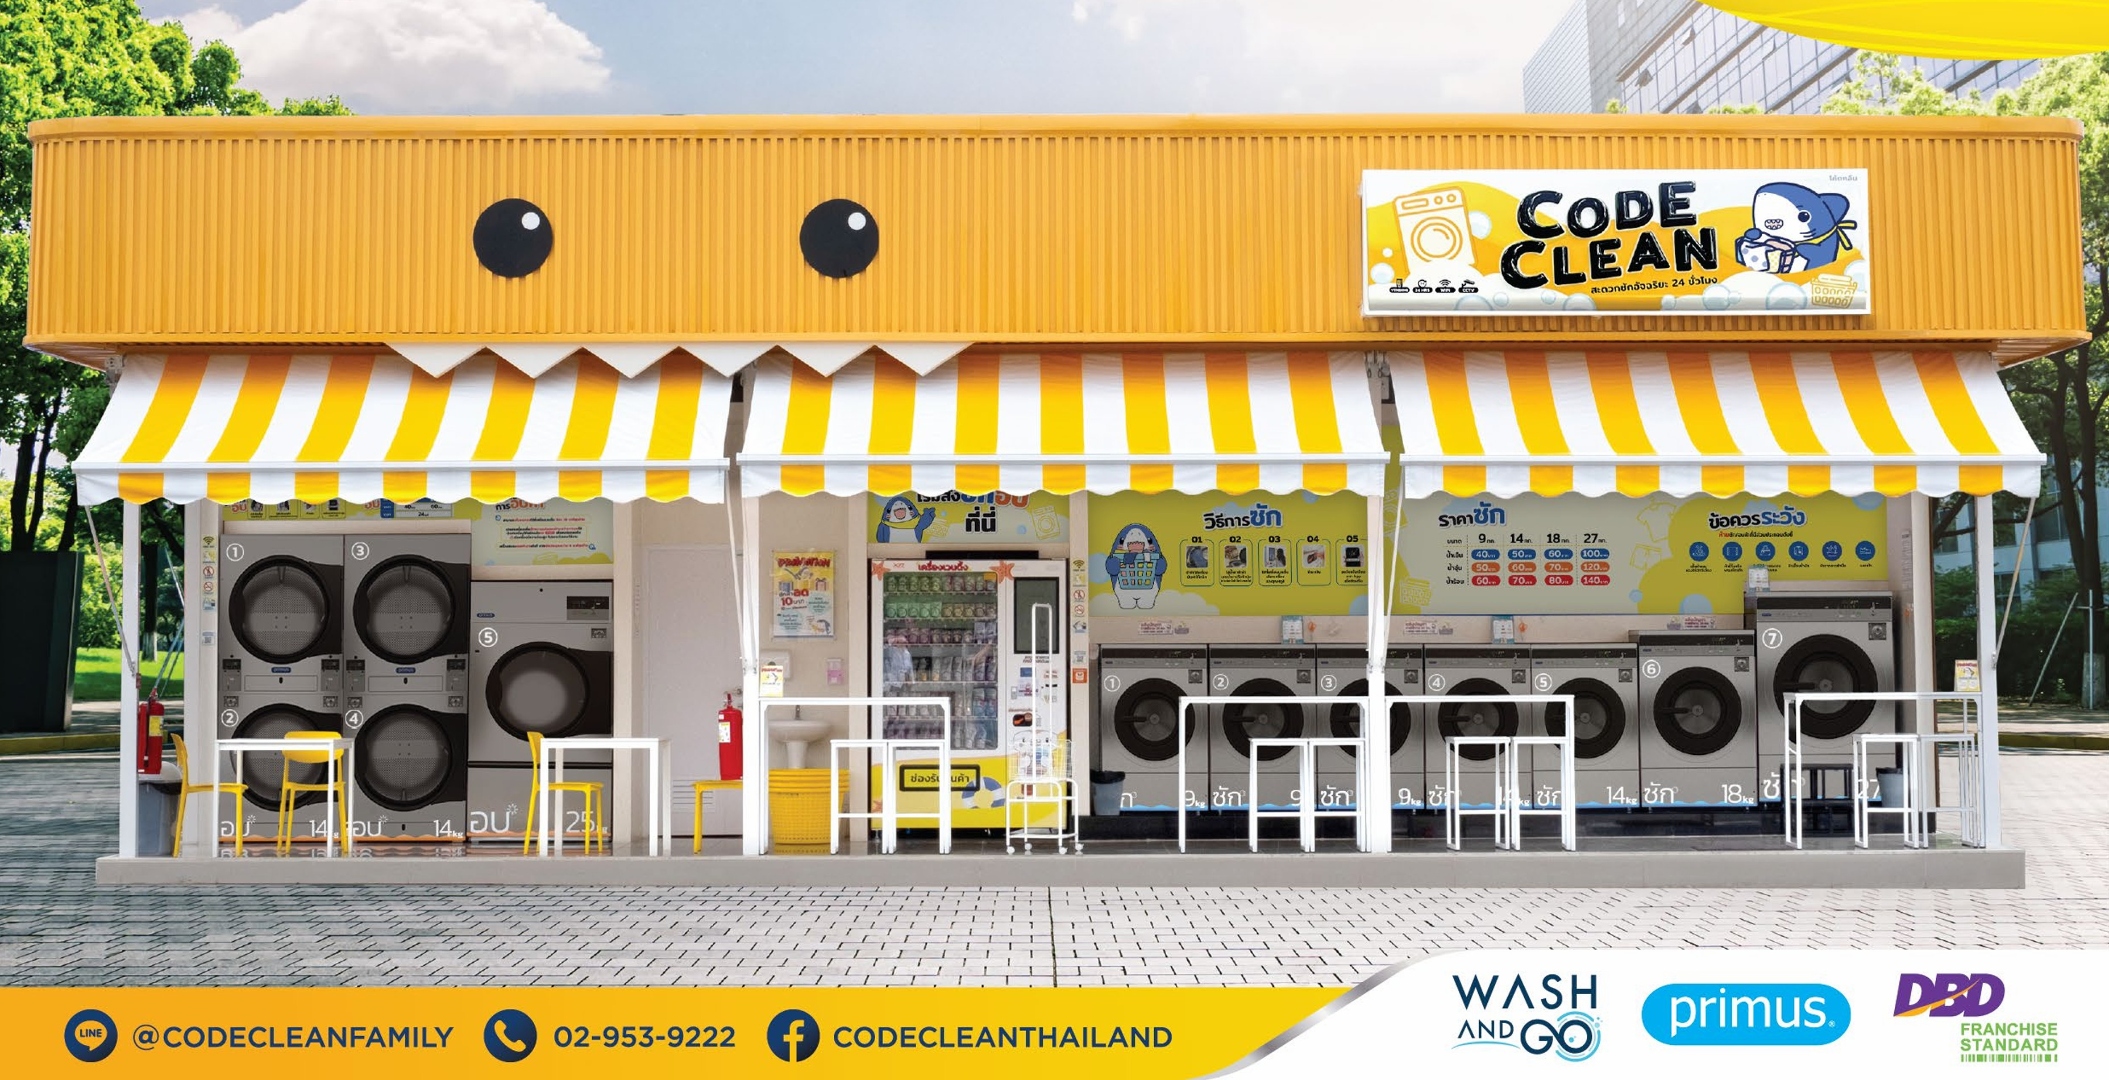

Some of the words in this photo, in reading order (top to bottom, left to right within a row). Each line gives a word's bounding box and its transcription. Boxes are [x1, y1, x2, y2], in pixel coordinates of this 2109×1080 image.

[1500, 227, 1719, 289] CLEAN
[1672, 278, 1685, 287] 24
[1688, 275, 1718, 285] ชั่วโมง
[965, 506, 996, 532] ที่นี่
[1203, 503, 1281, 529] วิธีการซัก
[1438, 502, 1505, 527] ราคาซัก
[1708, 506, 1805, 529] ข้อควรระวัง
[1229, 535, 1241, 543] 02
[1268, 535, 1280, 543] 03
[1510, 533, 1523, 543] 14
[1547, 533, 1560, 543] 18
[1584, 533, 1598, 543] 27
[1213, 786, 1242, 807] ซัก
[1320, 785, 1349, 807] ซัก
[1644, 782, 1674, 804] ซัก
[352, 820, 382, 837] อบ
[470, 811, 510, 834] อบ
